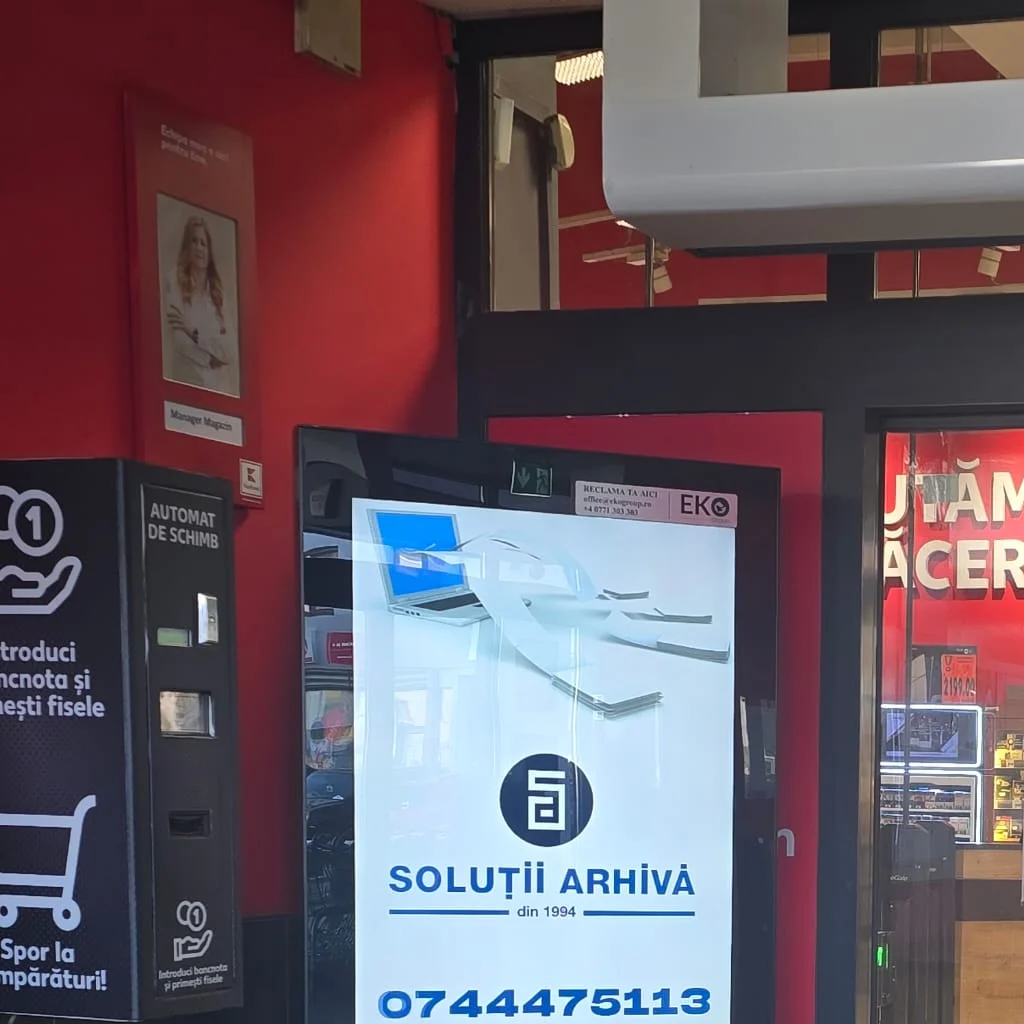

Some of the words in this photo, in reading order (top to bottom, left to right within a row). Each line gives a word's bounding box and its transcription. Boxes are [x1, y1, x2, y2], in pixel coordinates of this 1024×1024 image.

[170, 408, 202, 425] Manager
[203, 416, 233, 432] Magazin
[583, 484, 625, 496] RECLAMA
[626, 489, 638, 497] TA
[640, 490, 658, 499] AICI
[150, 502, 216, 528] AUTOMAT
[148, 524, 167, 541] DE
[169, 527, 219, 549] SCHIMB
[74, 669, 91, 695] și
[0, 695, 42, 721] ești
[47, 695, 106, 718] fisele
[517, 906, 539, 918] din
[543, 905, 576, 918] 1994
[0, 938, 50, 965] Spor
[55, 941, 75, 963] la
[159, 966, 192, 979] Introduci
[378, 987, 711, 1018] 0744475113
